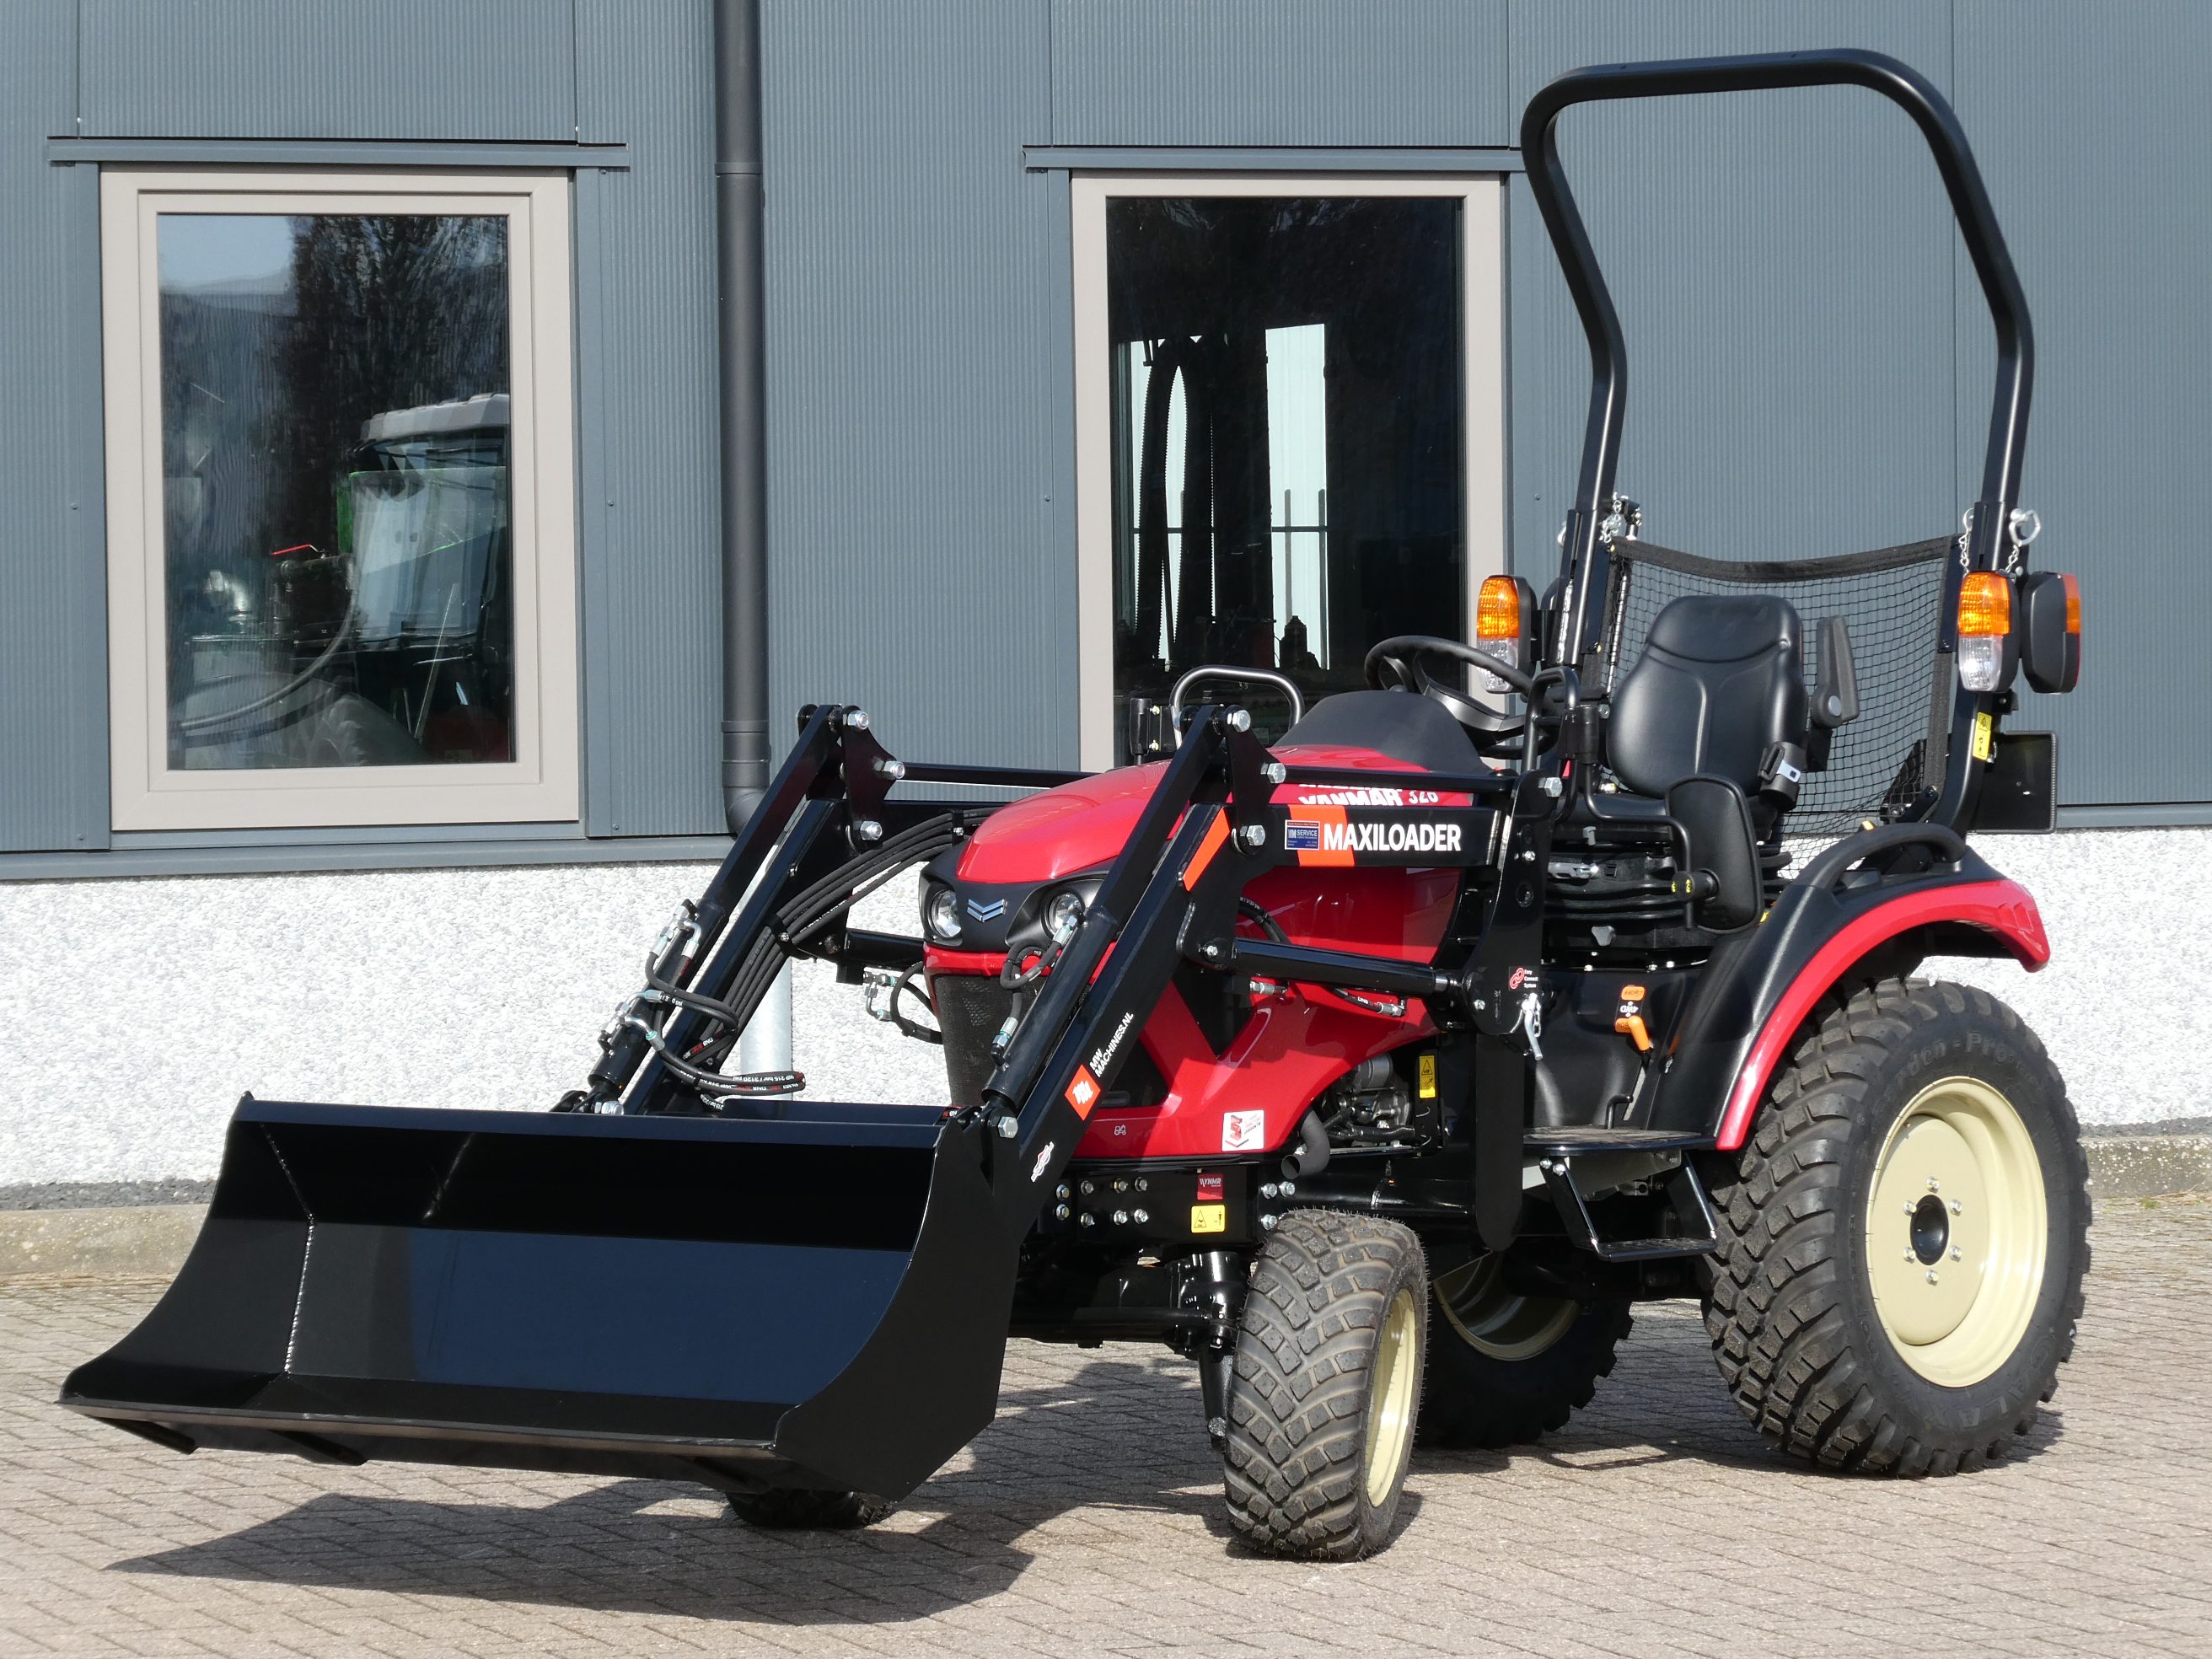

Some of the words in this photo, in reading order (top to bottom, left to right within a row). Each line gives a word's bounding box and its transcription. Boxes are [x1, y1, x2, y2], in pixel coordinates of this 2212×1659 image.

[1324, 824, 1461, 851] MAXILOADER
[1620, 1005, 1639, 1013] 4WD
[1094, 1012, 1134, 1077] MACHINES.NL
[1089, 1048, 1103, 1070] MW
